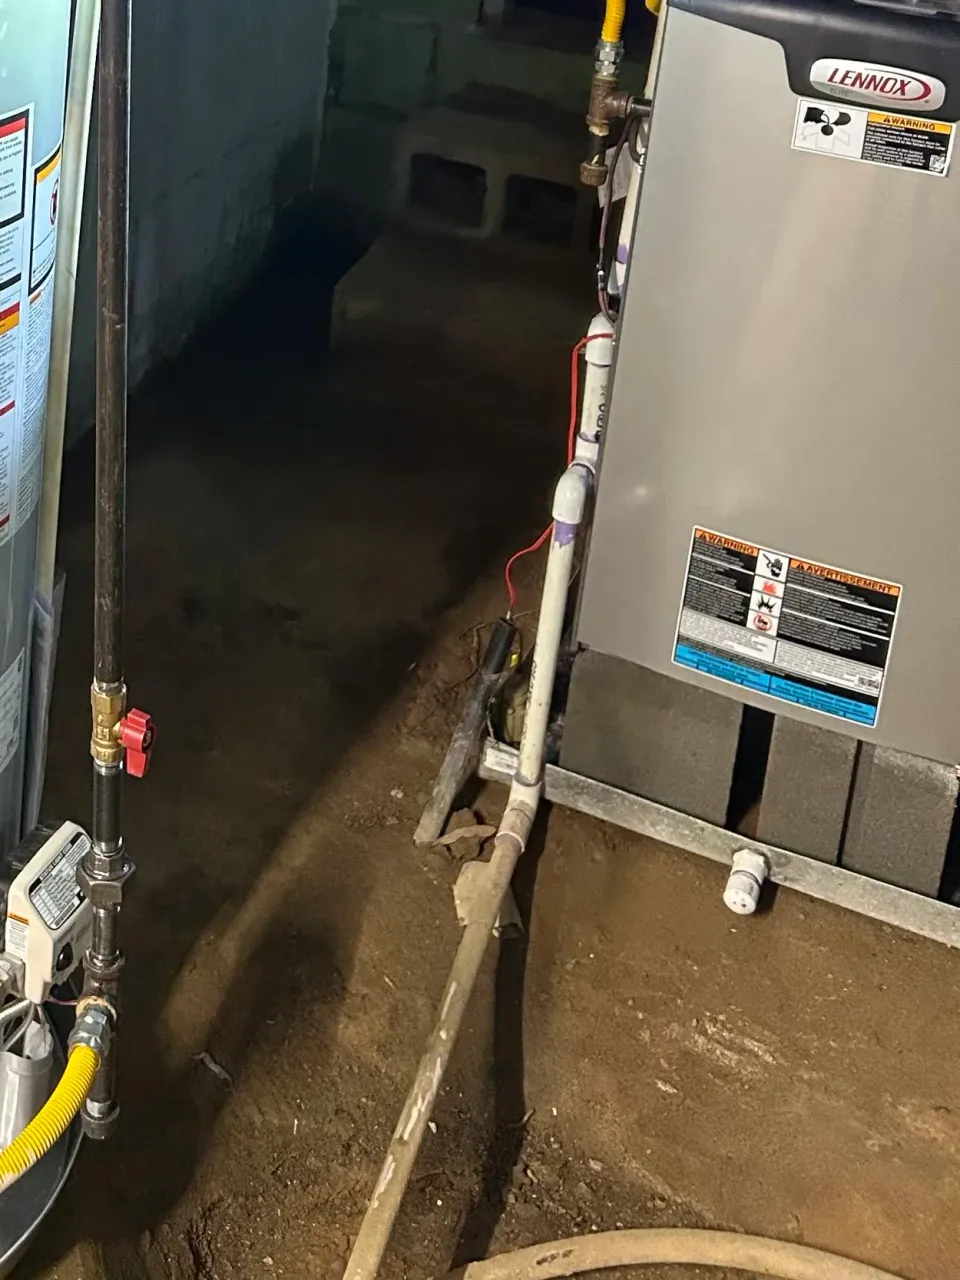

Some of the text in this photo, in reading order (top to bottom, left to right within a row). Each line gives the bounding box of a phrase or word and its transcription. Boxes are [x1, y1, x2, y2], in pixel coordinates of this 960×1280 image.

[828, 68, 912, 96] LENNOX
[892, 118, 935, 130] WARNING
[707, 534, 755, 555] WARNING
[806, 564, 893, 594] AVERTISSEMENT
